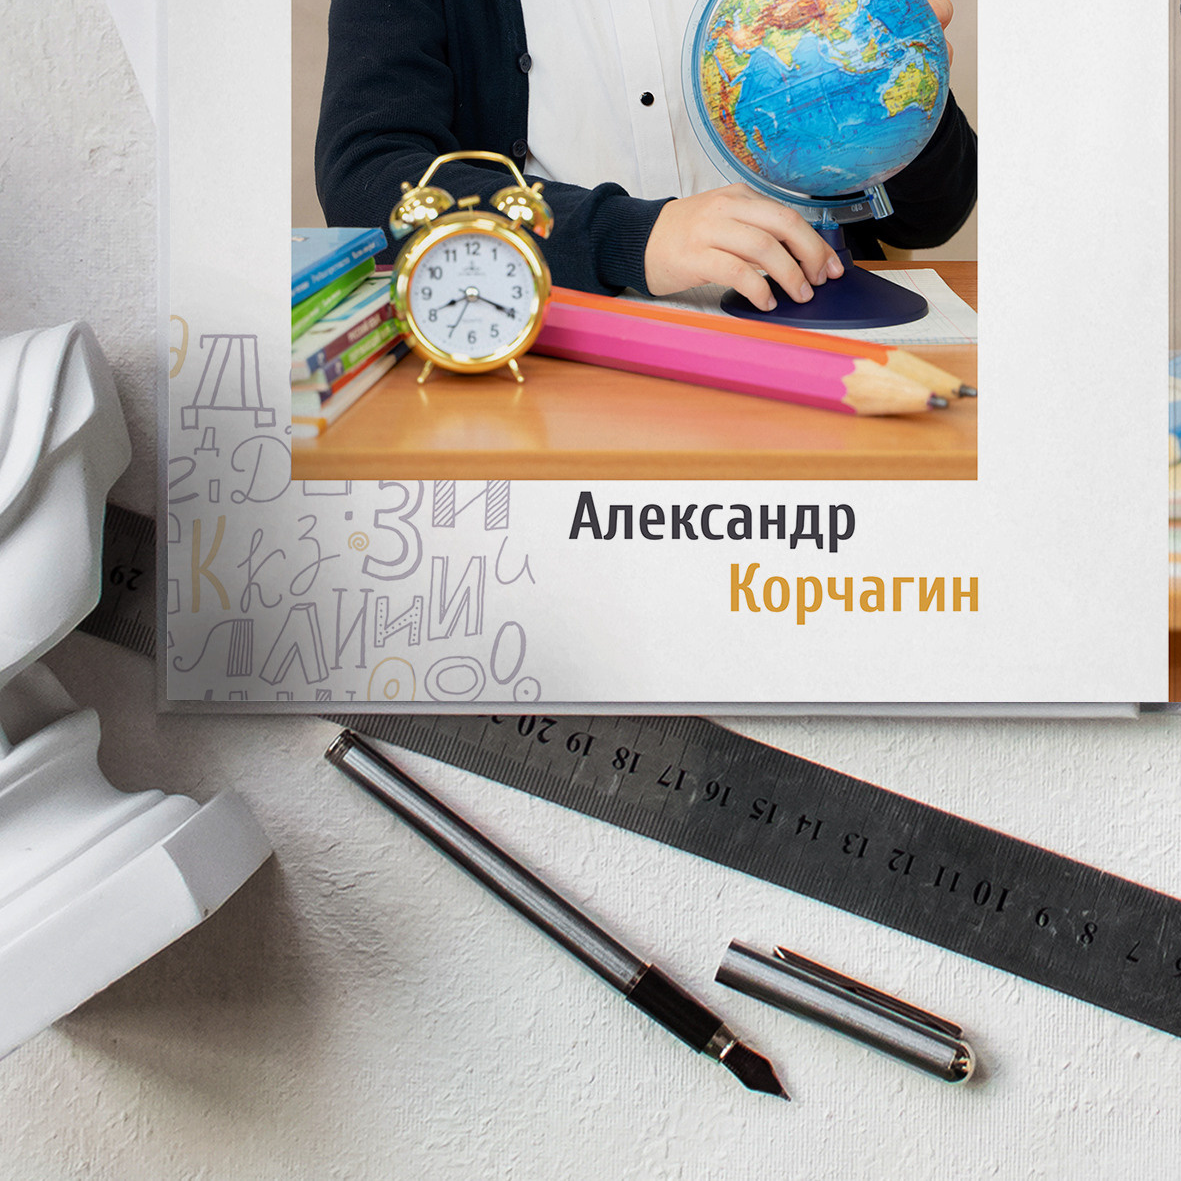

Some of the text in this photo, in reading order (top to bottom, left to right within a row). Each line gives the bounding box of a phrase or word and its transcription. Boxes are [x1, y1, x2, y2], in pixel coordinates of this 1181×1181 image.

[444, 249, 457, 262] 11
[465, 241, 480, 256] 12
[492, 248, 498, 261] 1
[428, 266, 443, 280] 10
[506, 263, 516, 277] 2
[421, 287, 432, 300] 9
[512, 286, 522, 299] 3
[428, 308, 438, 322] 8
[468, 331, 476, 344] 6
[490, 324, 500, 337] 5
[568, 491, 856, 553] Александр
[730, 562, 979, 625] Корчагин
[517, 716, 557, 744] 20
[566, 731, 596, 757] 19
[612, 747, 642, 774] 18
[656, 764, 688, 791] 17
[705, 780, 732, 807] 16
[750, 797, 778, 825] 15
[795, 814, 823, 841] 14
[842, 832, 870, 859] 13
[888, 848, 916, 875] 12
[934, 865, 961, 893] 11
[973, 879, 1010, 912] 10
[1035, 907, 1049, 928] 9
[1080, 922, 1098, 945] 8
[1126, 940, 1141, 963] 7
